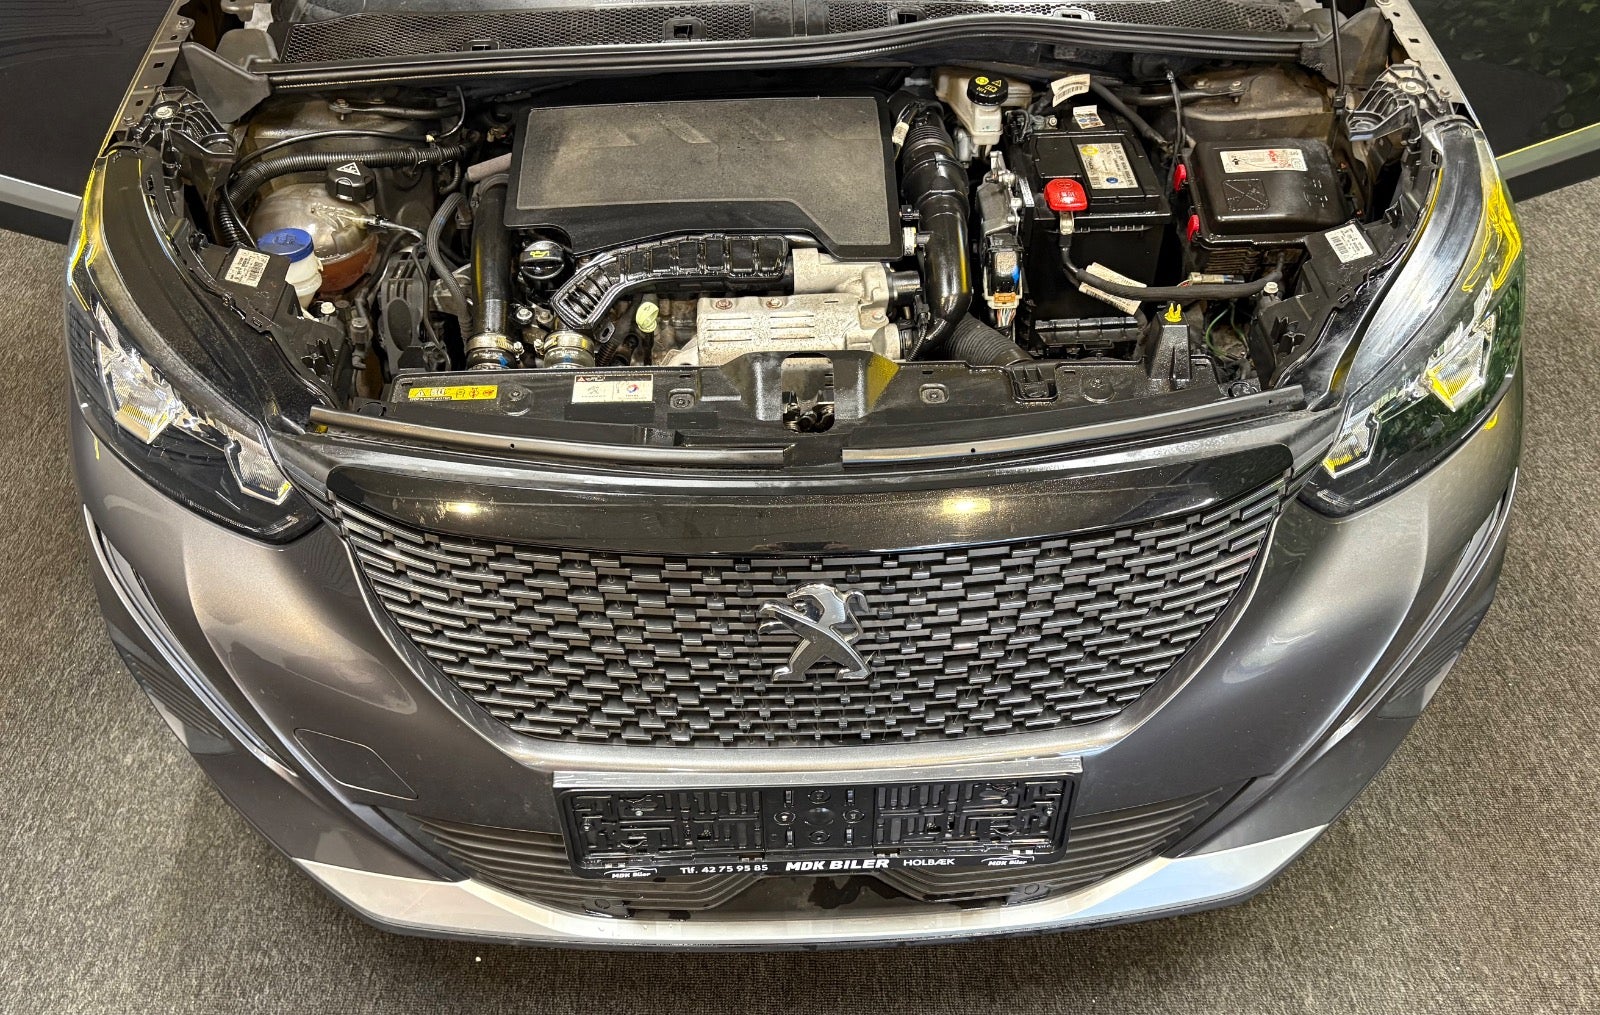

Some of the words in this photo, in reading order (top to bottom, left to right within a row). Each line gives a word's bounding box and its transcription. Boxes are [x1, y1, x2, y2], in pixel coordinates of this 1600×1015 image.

[785, 861, 825, 871] MDK
[829, 859, 890, 870] BILER
[903, 858, 956, 866] HOLBÆK
